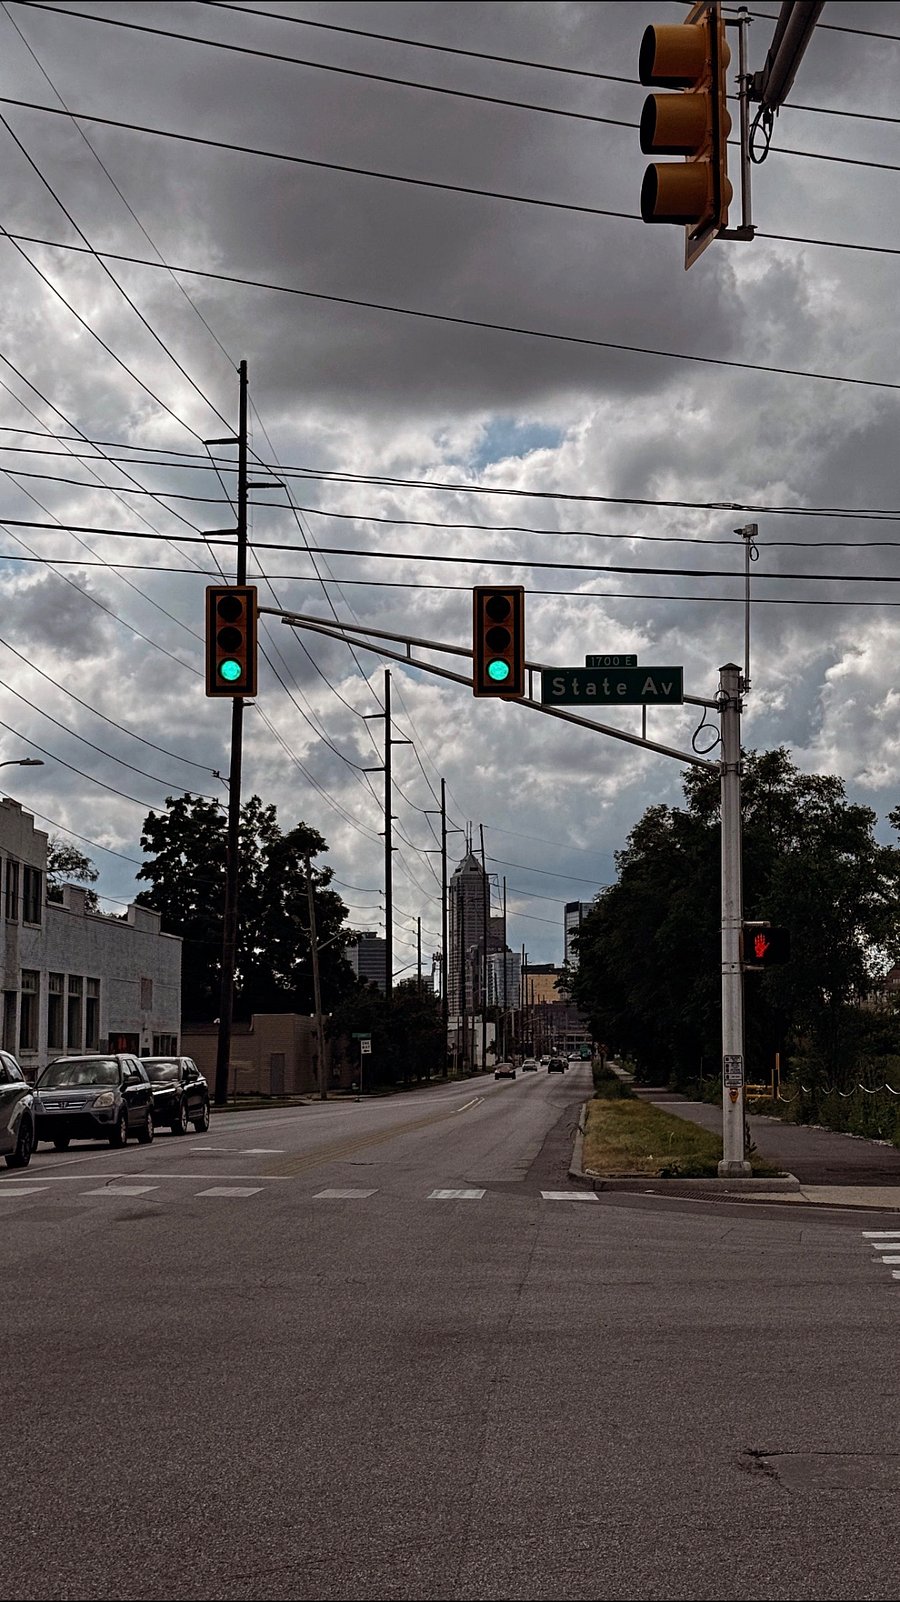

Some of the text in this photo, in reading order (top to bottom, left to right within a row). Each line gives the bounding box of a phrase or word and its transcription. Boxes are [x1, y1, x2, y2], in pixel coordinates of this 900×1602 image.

[591, 656, 632, 667] 1700 E
[552, 676, 673, 696] State Av
